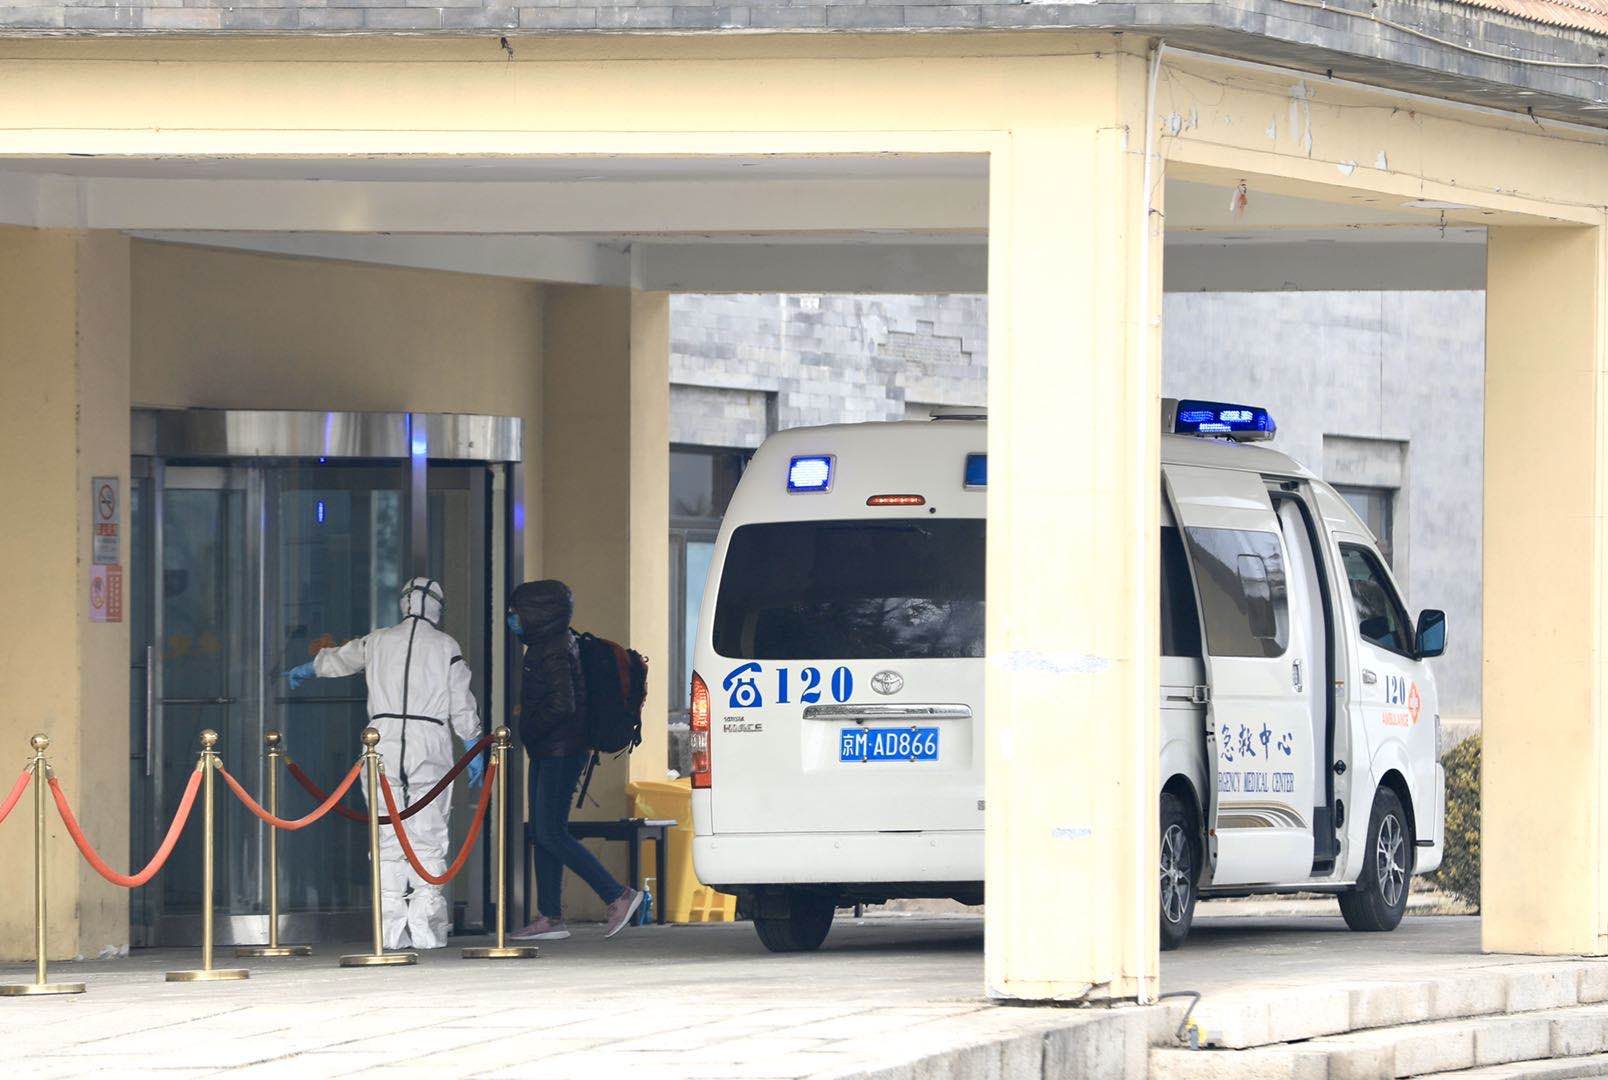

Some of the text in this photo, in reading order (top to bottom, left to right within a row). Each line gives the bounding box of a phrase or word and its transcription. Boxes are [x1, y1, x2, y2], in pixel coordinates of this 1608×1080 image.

[776, 666, 853, 704] 120
[1386, 675, 1406, 705] 120
[1220, 722, 1293, 762] 急救中心
[1217, 772, 1295, 793] RGENCY MEDICAL CENTER
